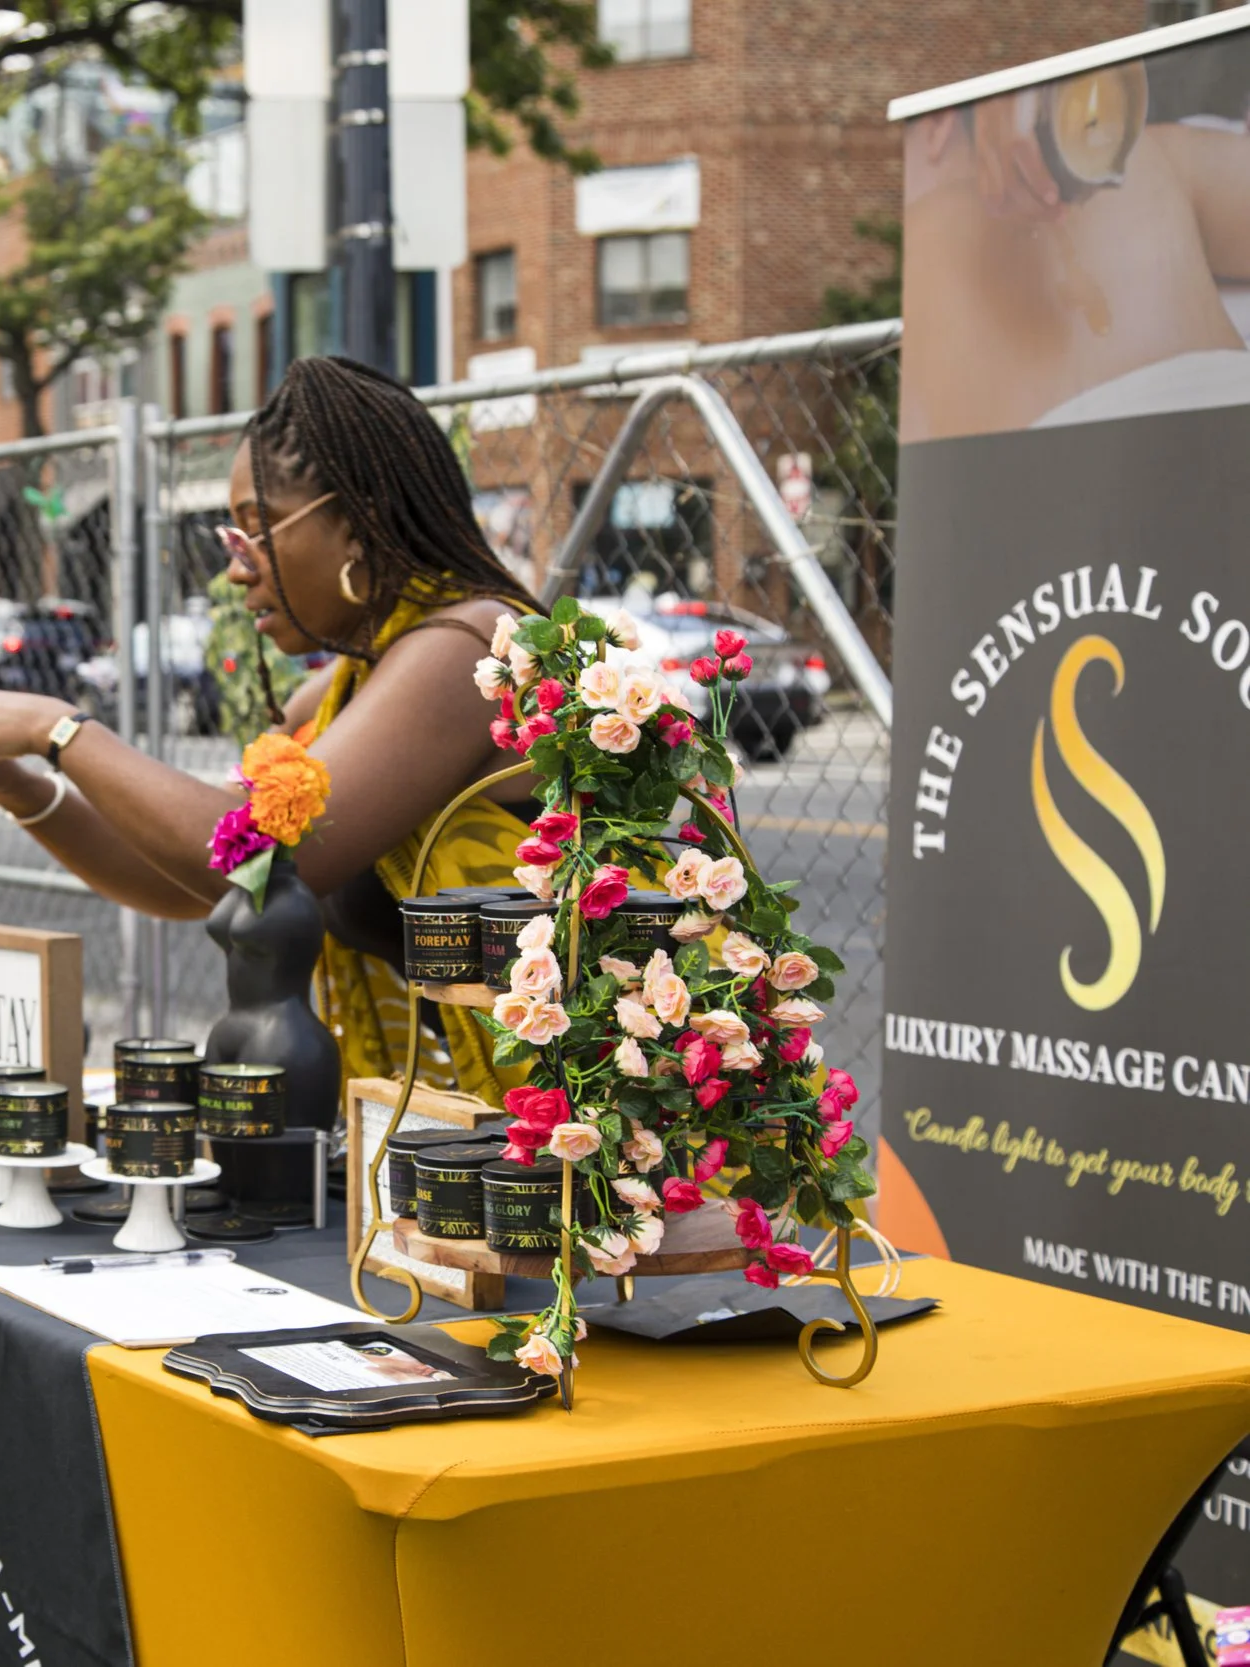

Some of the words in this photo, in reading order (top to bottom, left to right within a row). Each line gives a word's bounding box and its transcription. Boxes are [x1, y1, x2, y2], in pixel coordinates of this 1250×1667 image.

[912, 725, 964, 860] THE
[950, 562, 1162, 717] SENSUAL
[414, 935, 471, 947] FOREPLAY
[885, 1012, 1006, 1067] LUXURY
[1010, 1031, 1166, 1093] MASSAGE
[990, 1120, 1044, 1174] light
[1045, 1137, 1067, 1167] to
[1065, 1147, 1109, 1188] get
[1107, 1158, 1175, 1196] your
[1178, 1155, 1240, 1217] body
[495, 1203, 532, 1217] GLORY
[1022, 1235, 1089, 1280] MADE
[1092, 1254, 1159, 1296] WITH
[1163, 1266, 1214, 1308] THE
